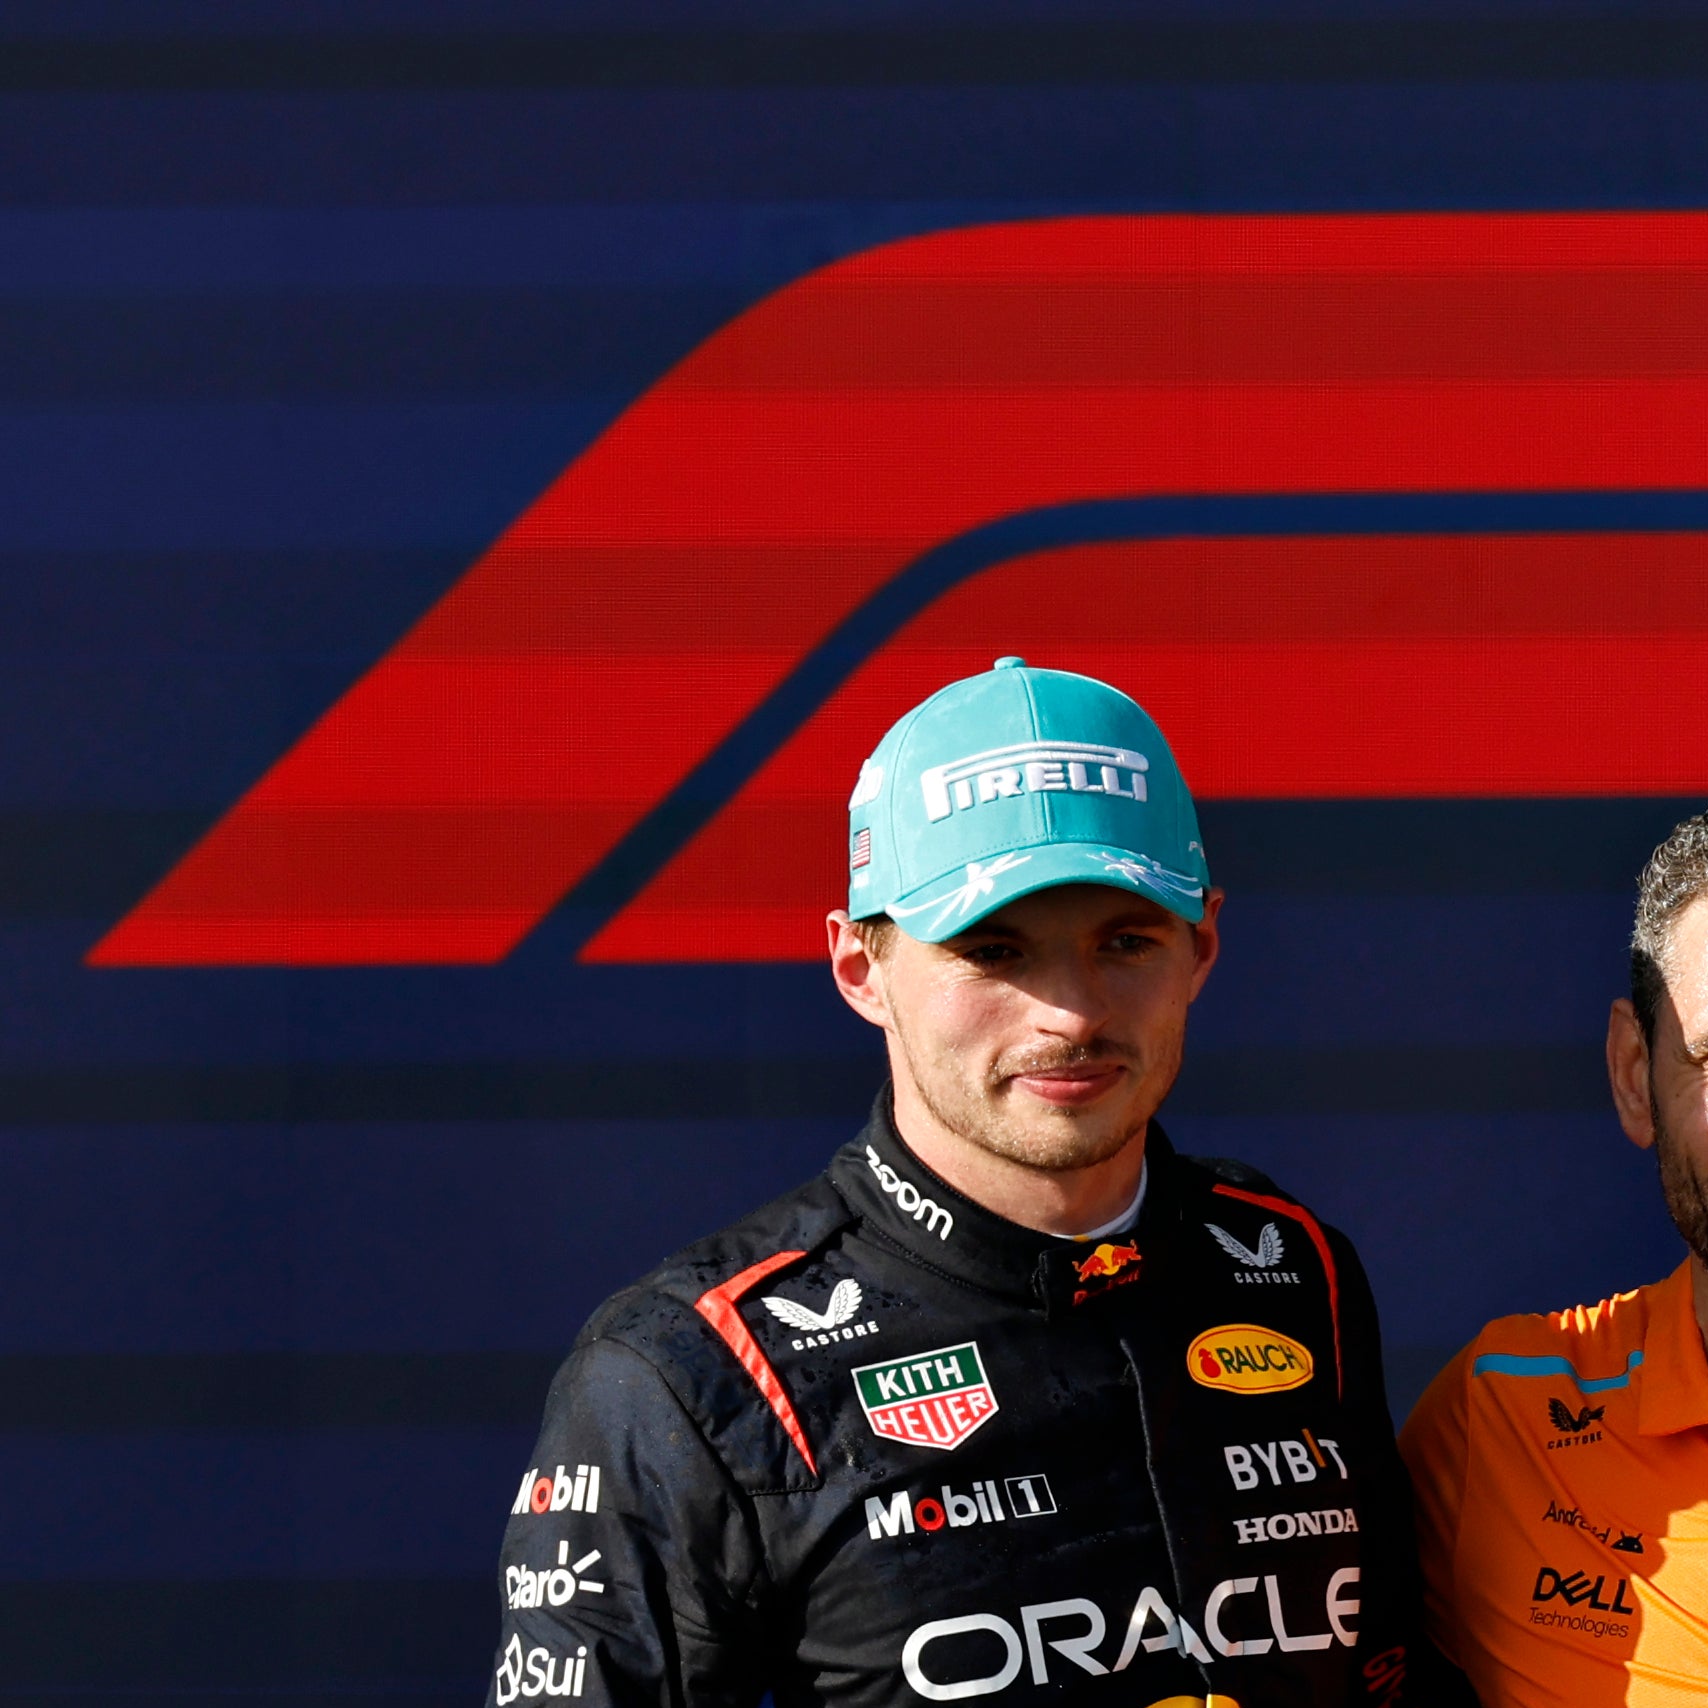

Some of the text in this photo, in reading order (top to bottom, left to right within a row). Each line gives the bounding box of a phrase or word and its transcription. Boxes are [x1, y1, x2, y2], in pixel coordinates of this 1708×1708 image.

[920, 740, 1149, 823] PIRELLI
[866, 1144, 954, 1240] zoom
[1234, 1271, 1301, 1284] CASTORE
[791, 1319, 880, 1351] CASTORE
[1216, 1344, 1306, 1375] RAUCH
[876, 1355, 965, 1400] KITH
[873, 1390, 990, 1446] HEUER
[1223, 1428, 1348, 1491] BYBIT
[510, 1464, 600, 1515] Mobil
[863, 1482, 1006, 1540] Mobil
[1233, 1508, 1359, 1544] HONDA
[1532, 1566, 1634, 1615] DELL
[901, 1566, 1361, 1701] ORACLE
[1528, 1606, 1630, 1638] Technologies
[525, 1646, 587, 1698] Sui
